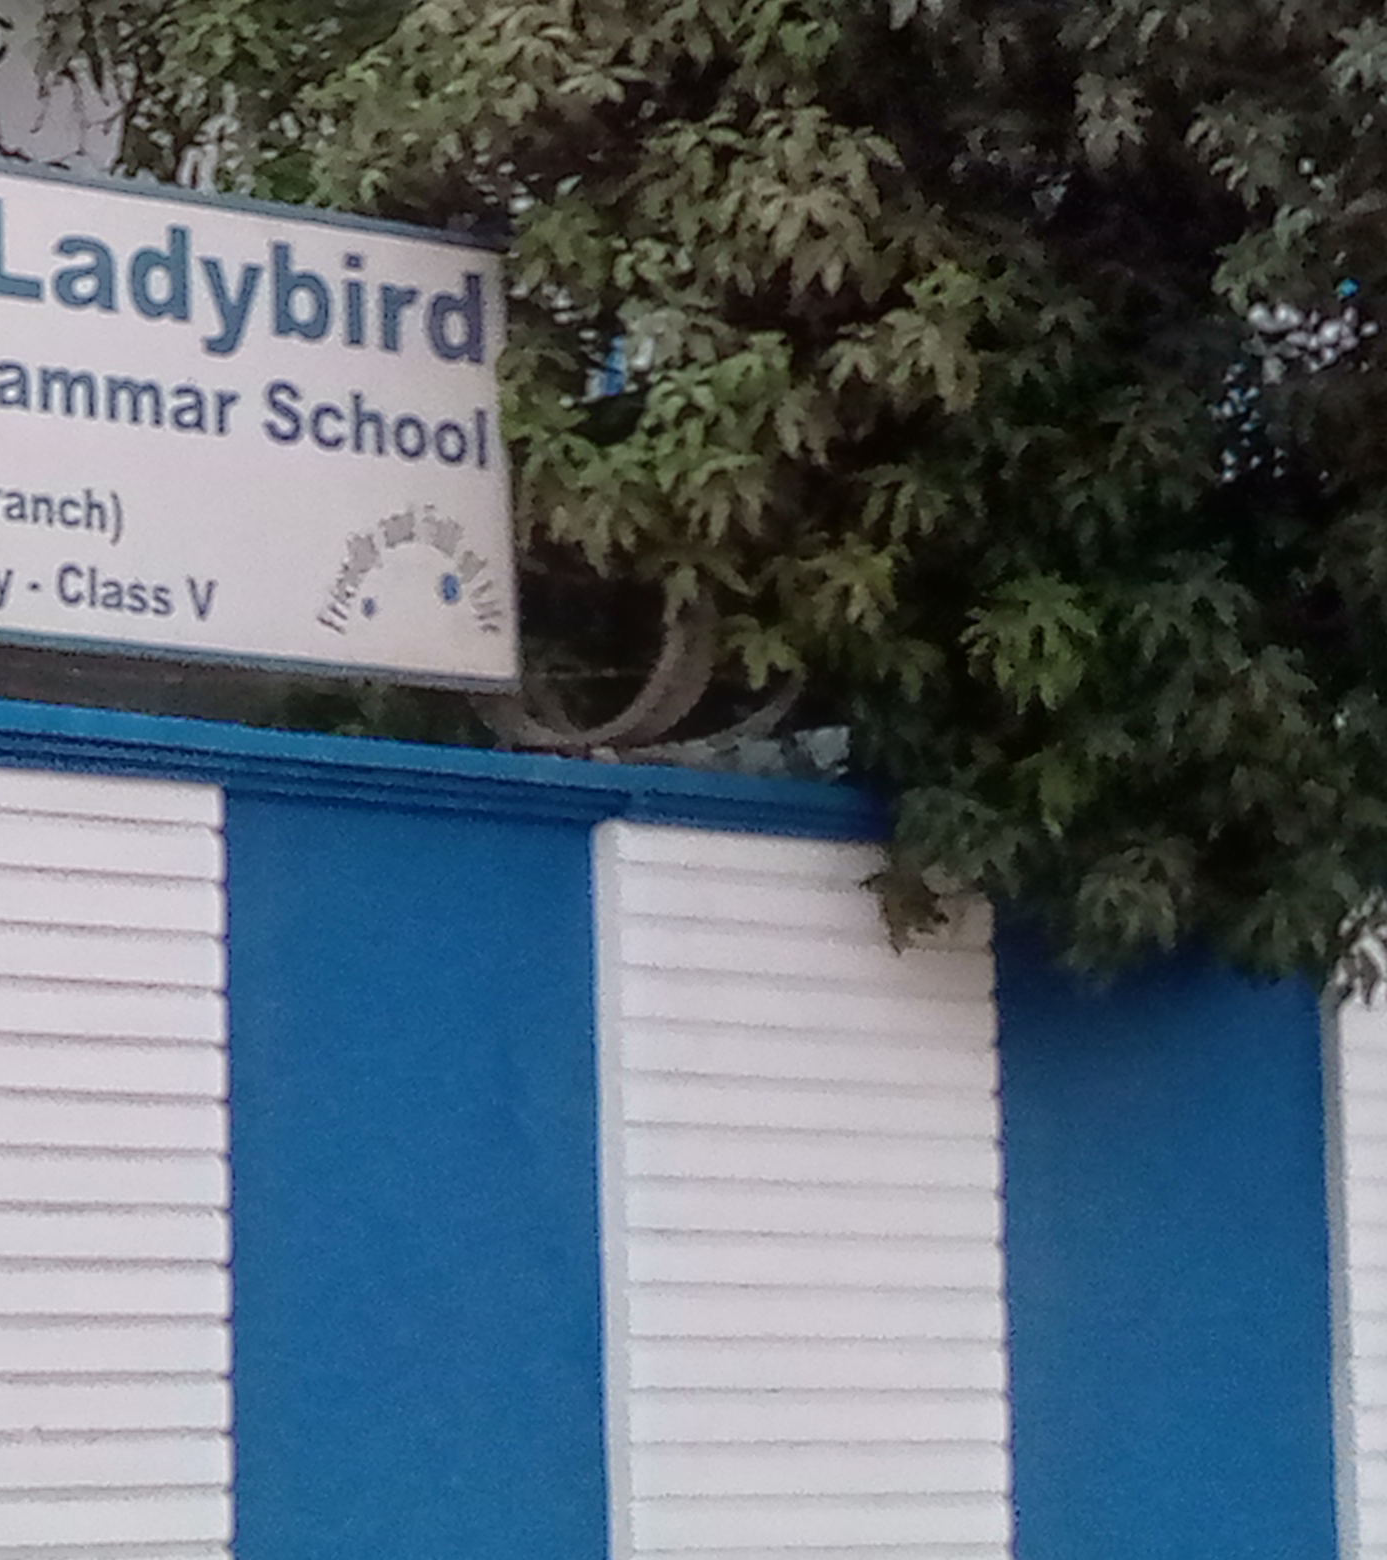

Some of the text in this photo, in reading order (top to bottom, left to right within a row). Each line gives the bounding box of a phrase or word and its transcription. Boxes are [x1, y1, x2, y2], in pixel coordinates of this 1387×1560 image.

[265, 383, 489, 469] School
[57, 564, 174, 618] Class
[187, 575, 218, 622] V
